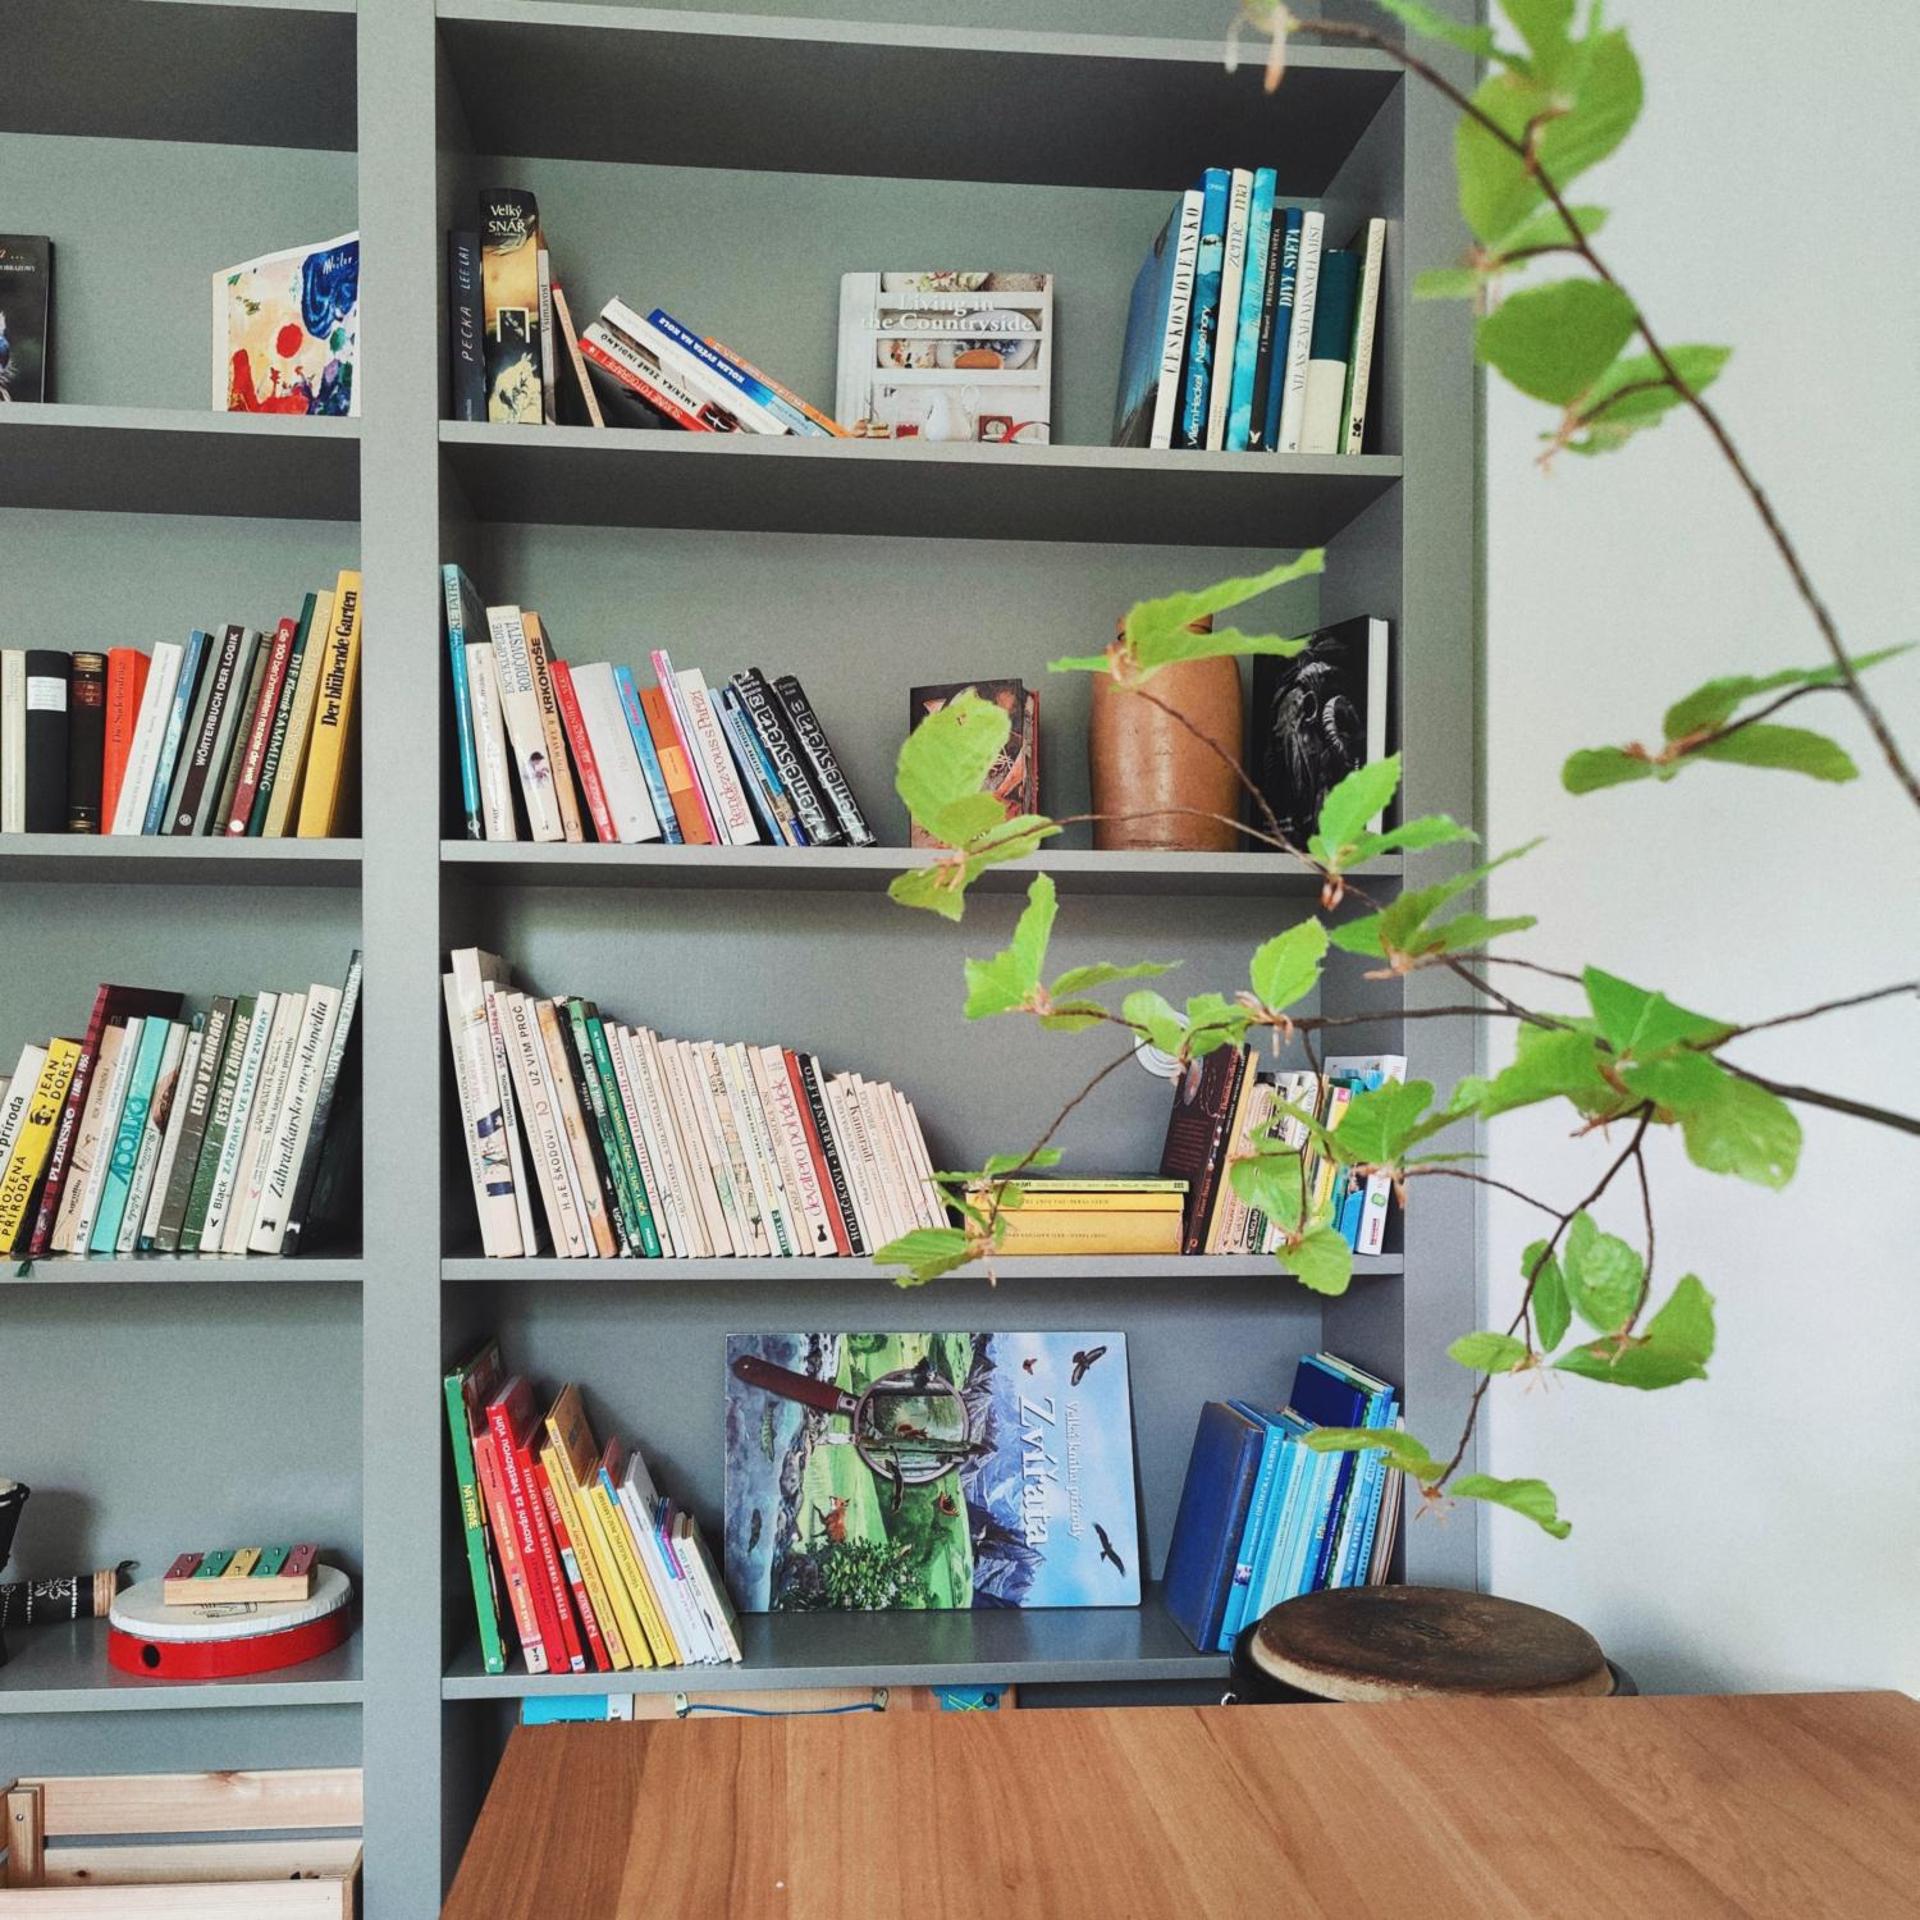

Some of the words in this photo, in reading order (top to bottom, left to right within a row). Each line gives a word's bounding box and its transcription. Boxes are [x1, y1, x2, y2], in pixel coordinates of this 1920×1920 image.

[488, 216, 526, 234] SNÁŘ
[490, 203, 524, 221] Velký
[900, 295, 967, 318] Living
[1278, 273, 1296, 307] DIVY
[460, 305, 474, 361] PECKA
[658, 316, 682, 336] KOLE
[680, 333, 694, 346] NA
[899, 312, 1033, 337] Countryside
[691, 342, 718, 365] SVĚTA
[716, 359, 746, 383] KOLEM
[661, 378, 699, 407] AMERIKA
[335, 590, 357, 638] Garten
[222, 632, 239, 668] LOGIK
[273, 641, 286, 659] 100
[287, 651, 302, 676] DIE
[215, 667, 230, 692] DER
[323, 637, 349, 701] blühende
[529, 636, 554, 715] KRKONOŠE
[194, 691, 224, 768] WÖRTERBUCH
[321, 700, 340, 727] Der
[258, 709, 288, 791] SAMMLUNG
[749, 705, 797, 771] světa
[790, 710, 838, 776] světa
[778, 763, 826, 828] Země
[817, 767, 866, 834] Země
[512, 1004, 529, 1038] PROČ
[38, 1058, 59, 1098] JEAN
[49, 1050, 76, 1101] DORST
[198, 1072, 211, 1082] V
[223, 1077, 236, 1087] V
[769, 1075, 808, 1148] pohádek
[212, 1180, 228, 1210] Black
[237, 1098, 248, 1113] VE
[789, 1147, 823, 1218] devatero
[832, 1167, 860, 1241] HOLEČKOVI
[1013, 1394, 1061, 1549] Zvířata
[514, 1495, 524, 1508] za
[516, 1508, 535, 1553] Putování
